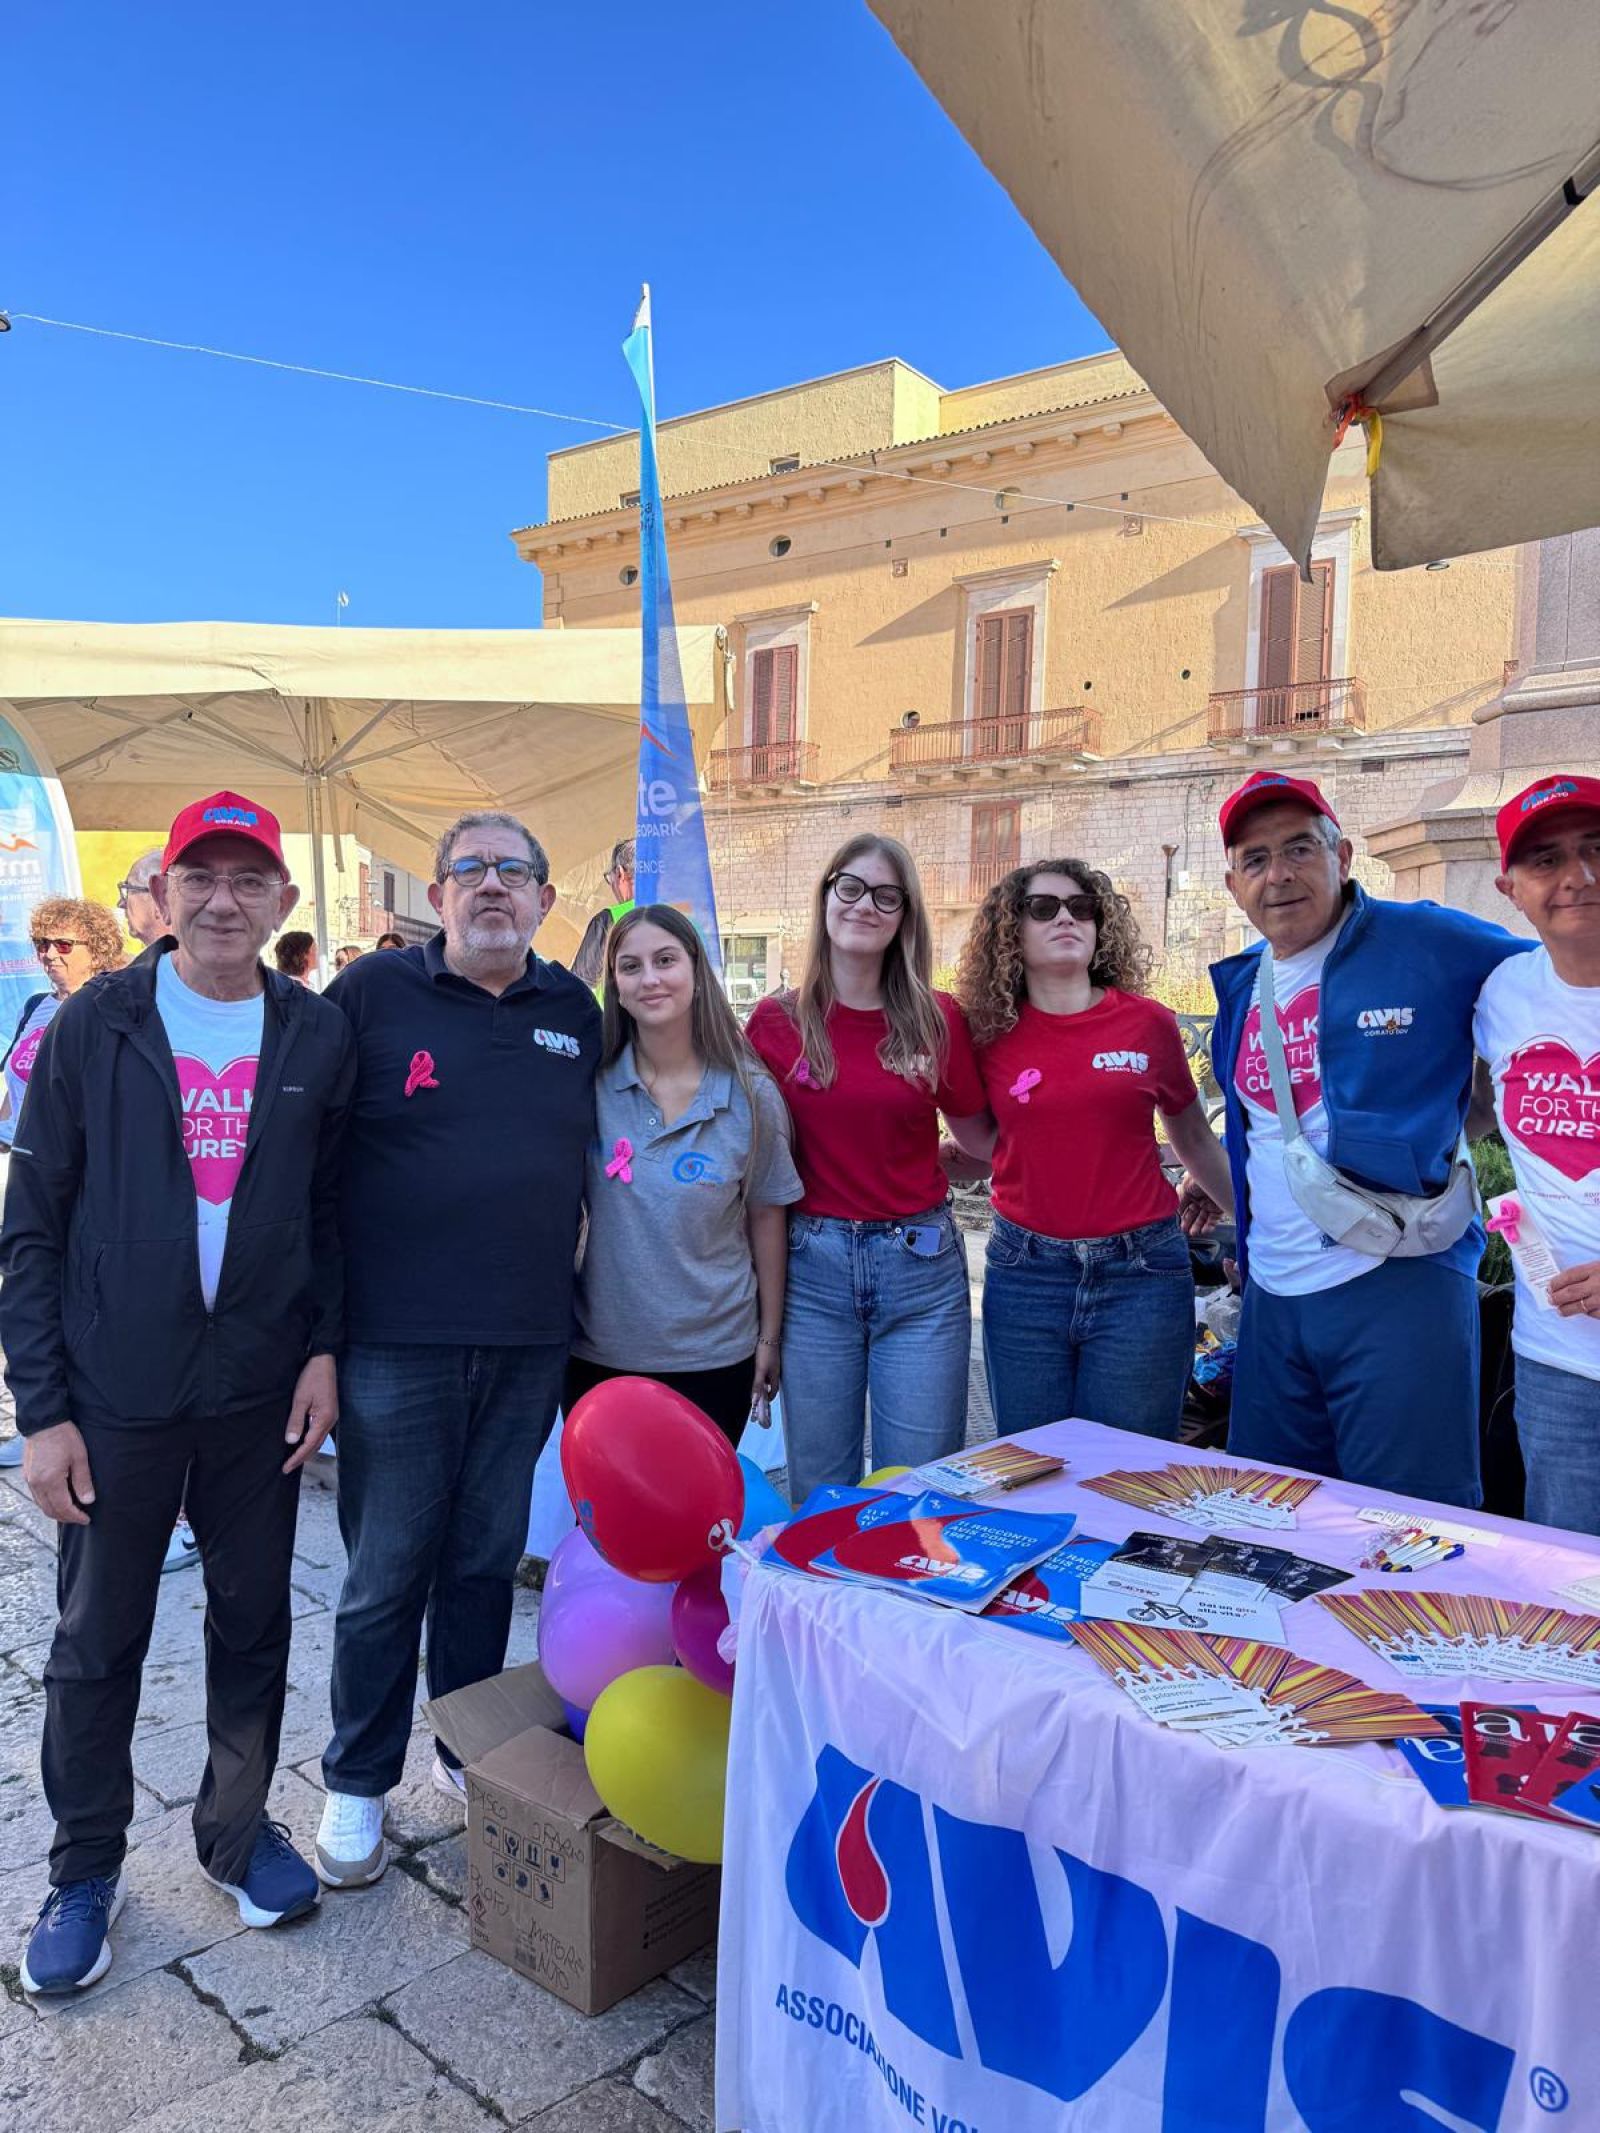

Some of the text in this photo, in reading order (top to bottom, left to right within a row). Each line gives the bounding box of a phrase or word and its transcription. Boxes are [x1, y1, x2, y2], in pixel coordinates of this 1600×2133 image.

[1356, 1007, 1415, 1029] AVIS
[533, 1028, 581, 1057] AVIS
[1248, 1014, 1319, 1053] WLK
[1091, 1050, 1150, 1073] AVIS
[1245, 1054, 1270, 1074] FO
[1245, 1067, 1304, 1093] CUE
[1519, 1094, 1571, 1118] FOR
[182, 1116, 214, 1137] OR
[1516, 1116, 1595, 1139] CURE
[182, 1138, 239, 1159] URE
[898, 1554, 990, 1581] AVIS
